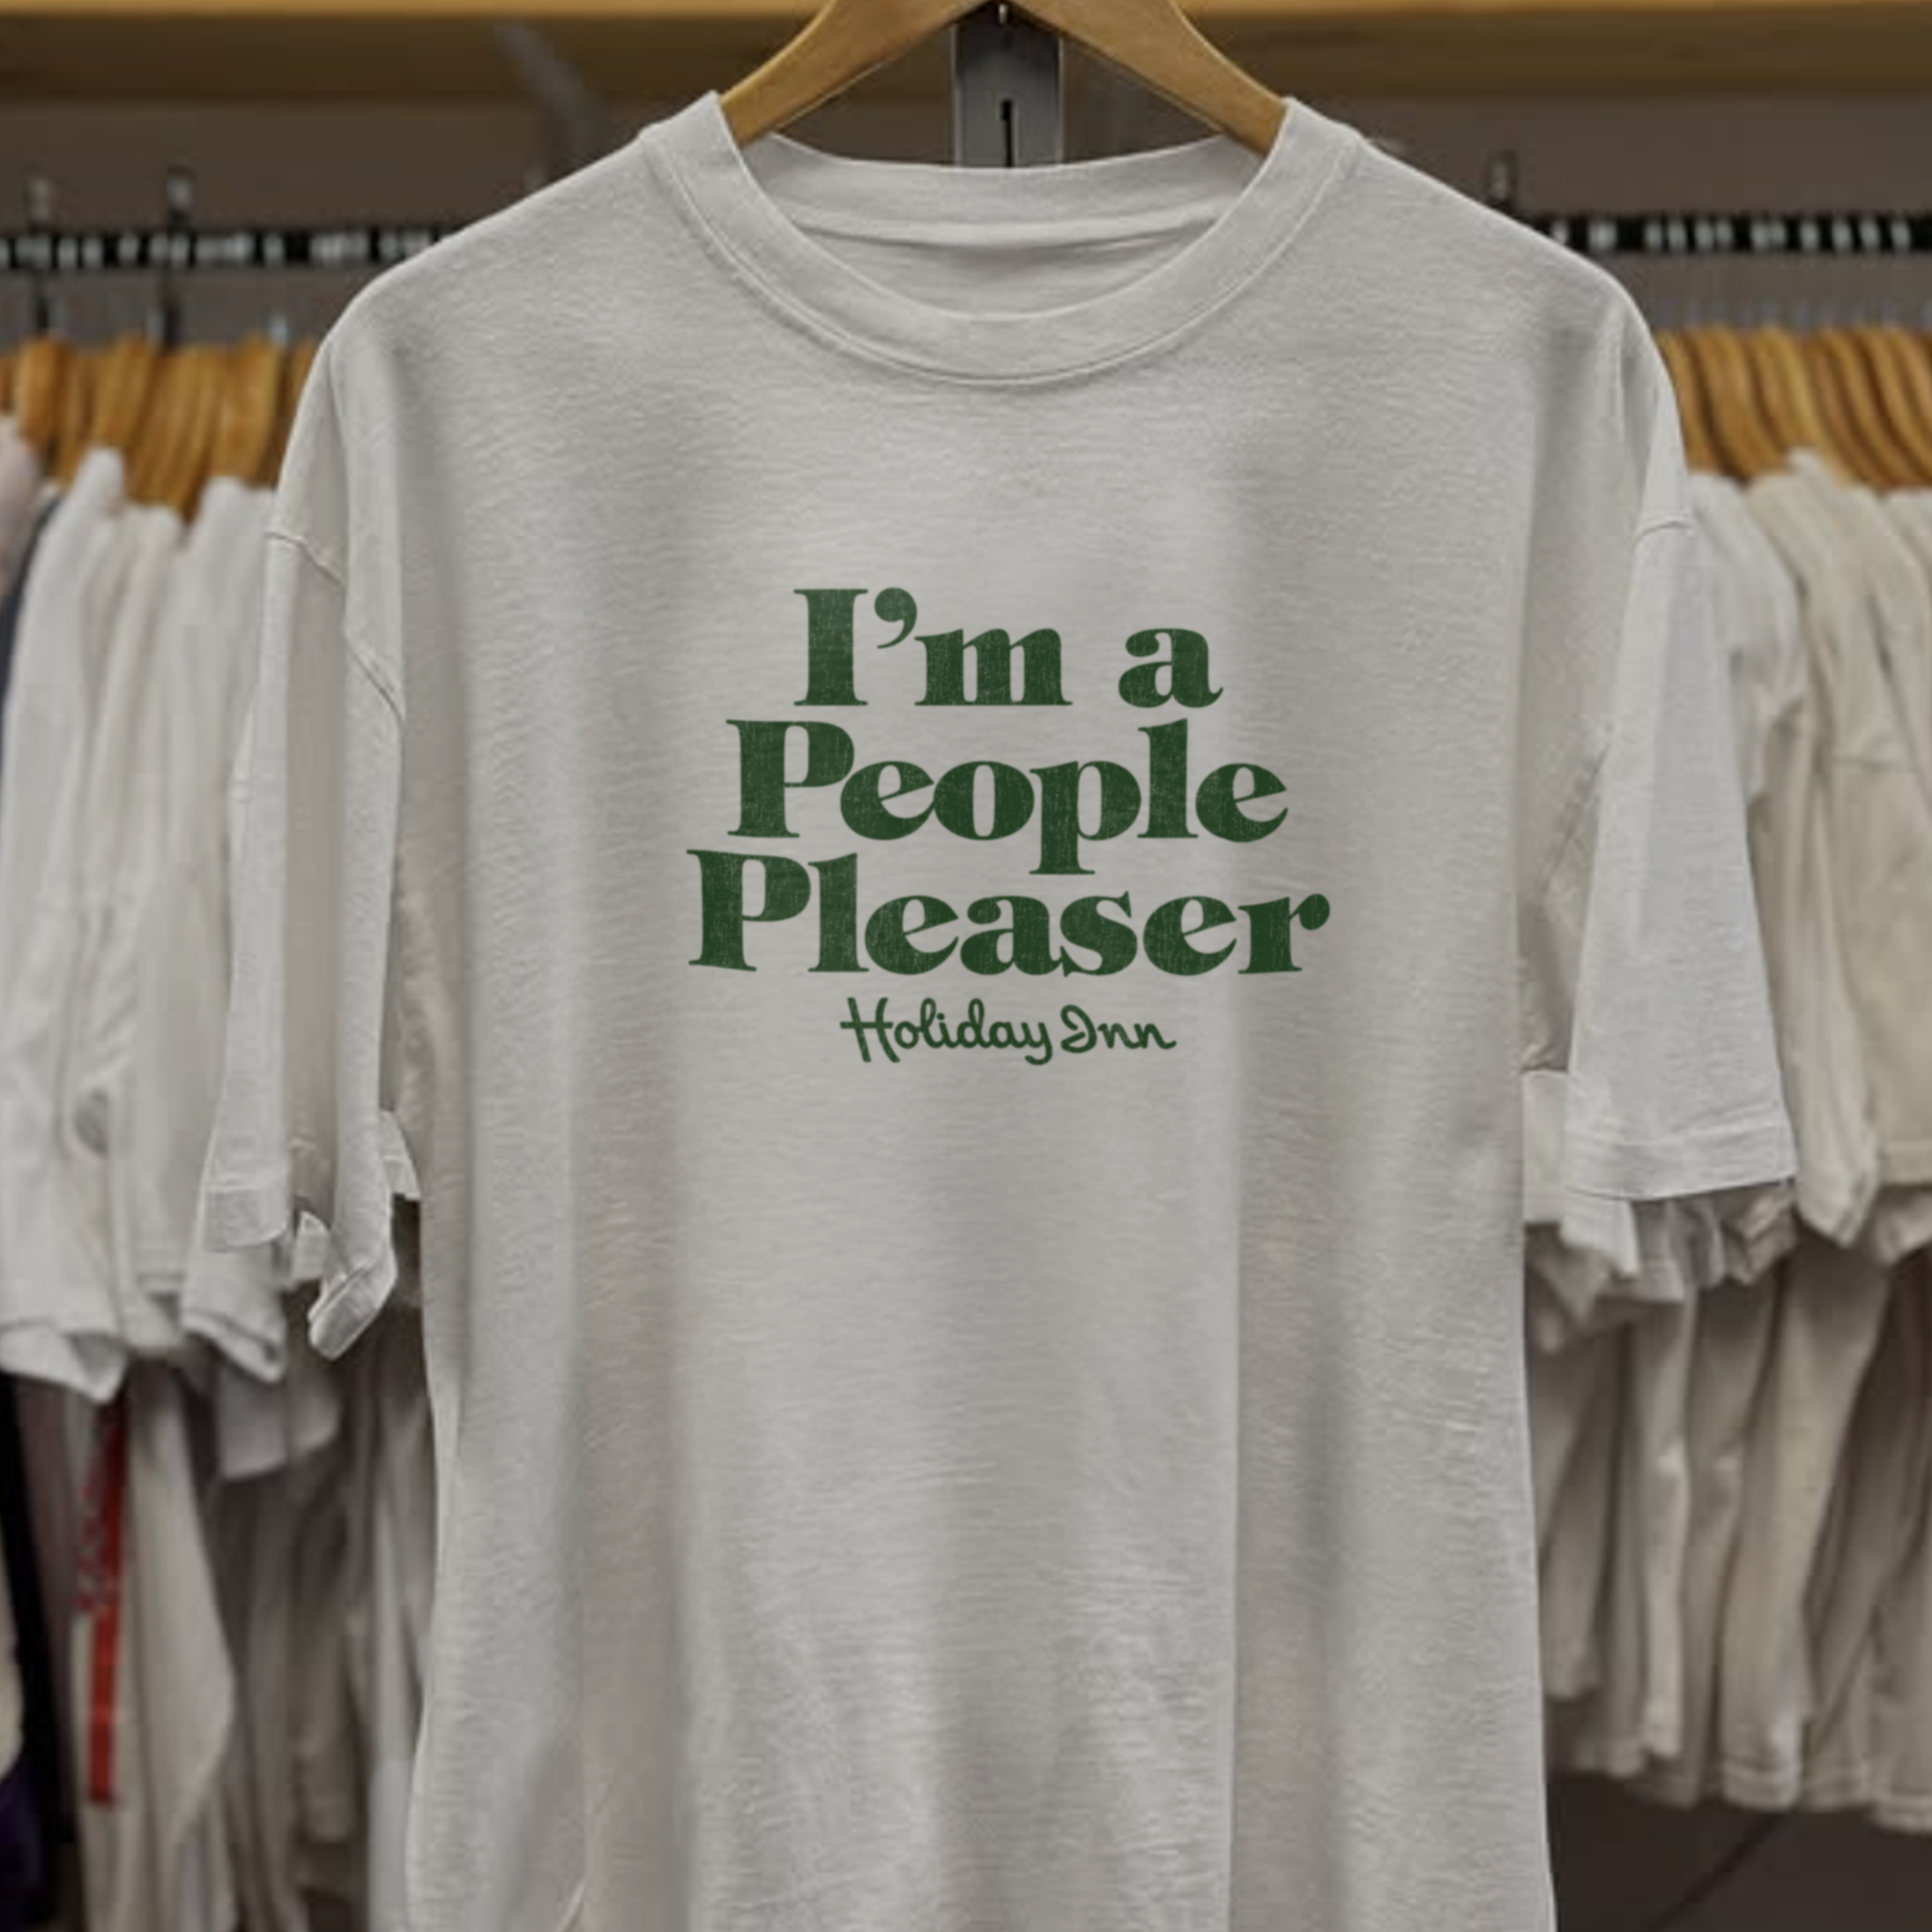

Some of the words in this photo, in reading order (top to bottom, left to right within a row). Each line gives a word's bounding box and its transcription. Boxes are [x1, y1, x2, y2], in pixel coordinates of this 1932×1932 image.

[794, 588, 1072, 707] I’m
[1119, 628, 1224, 709] a
[726, 719, 1289, 876] People
[686, 848, 1331, 977] Pleaser
[839, 997, 1053, 1066] Holiday
[1060, 1004, 1177, 1053] Inn
